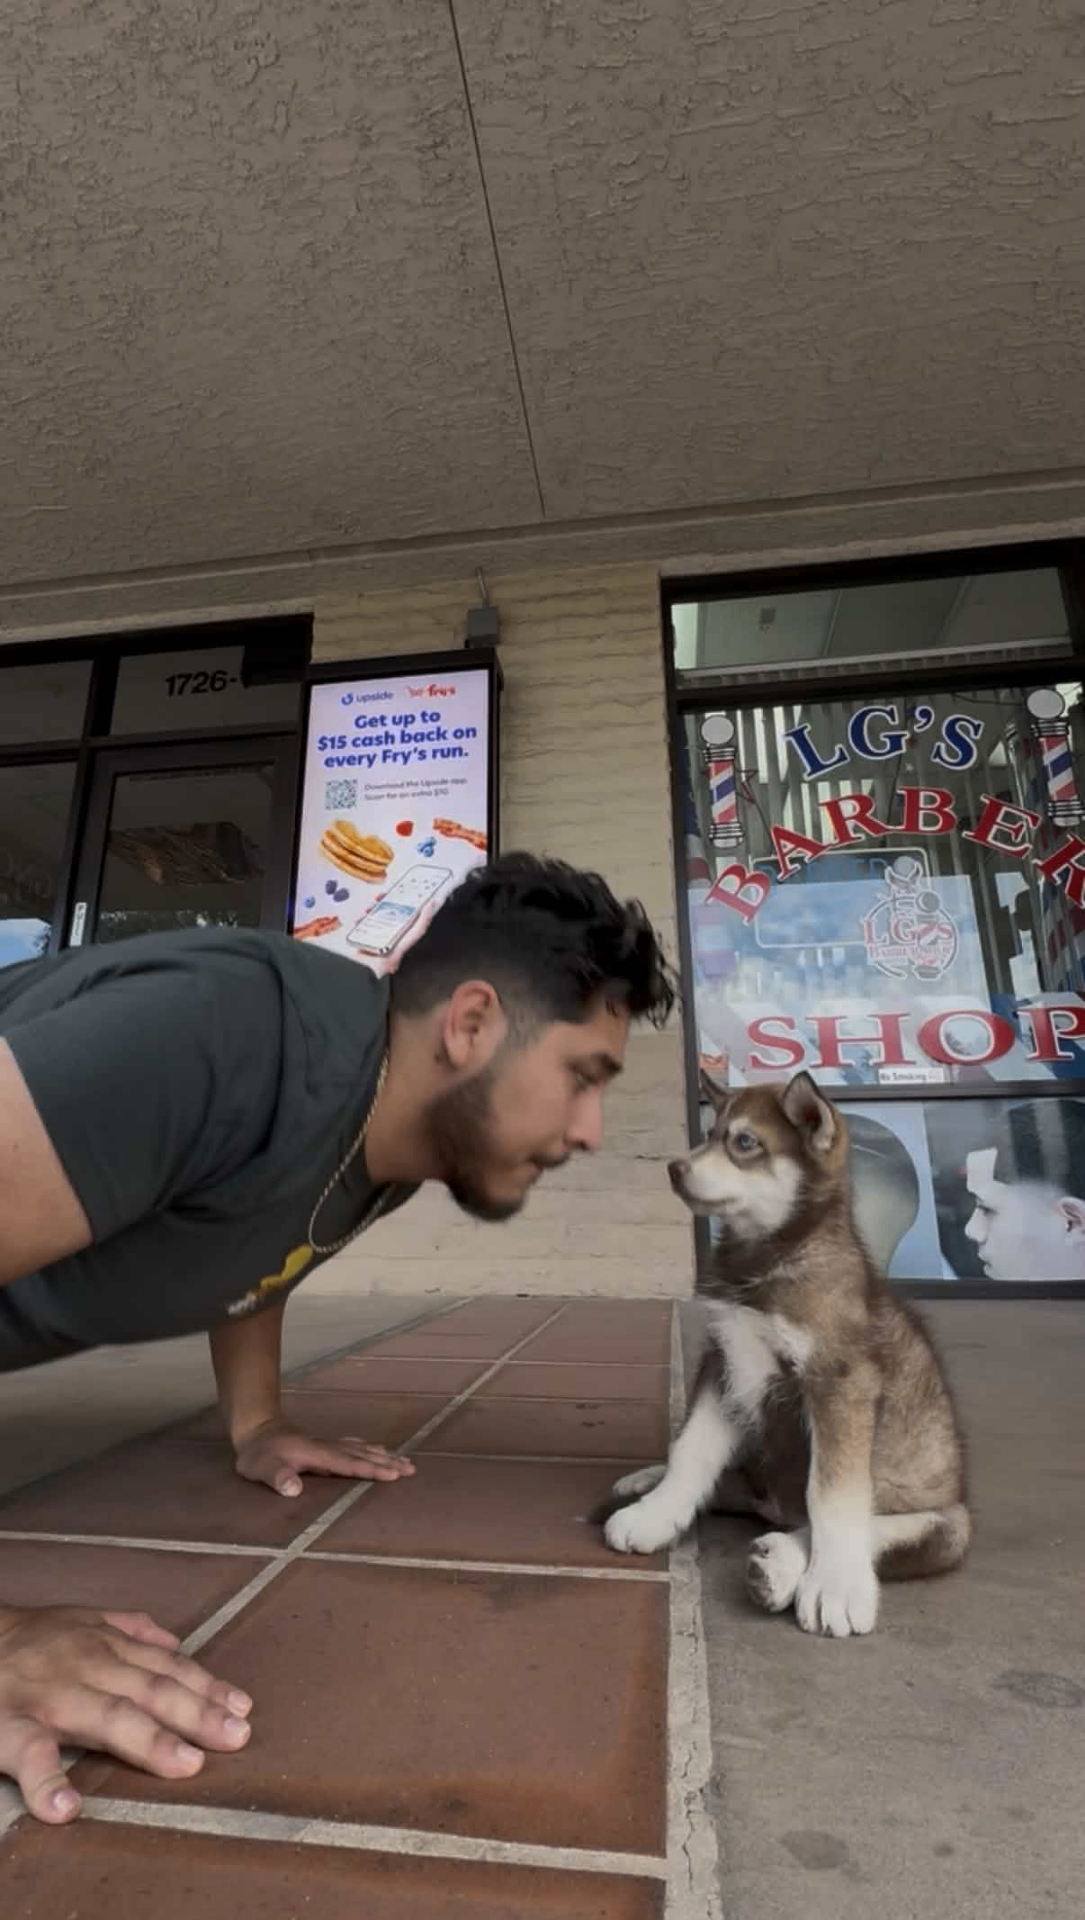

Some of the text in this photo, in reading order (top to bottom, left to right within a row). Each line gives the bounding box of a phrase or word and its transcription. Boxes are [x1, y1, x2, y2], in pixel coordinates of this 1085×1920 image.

[356, 690, 394, 704] upside
[354, 710, 441, 729] Get up to
[317, 726, 477, 751] $15 cash back on
[784, 705, 984, 781] LG'S
[323, 745, 469, 769] every Fry's run.
[406, 780, 419, 788] the
[746, 1004, 1085, 1071] SHOP
